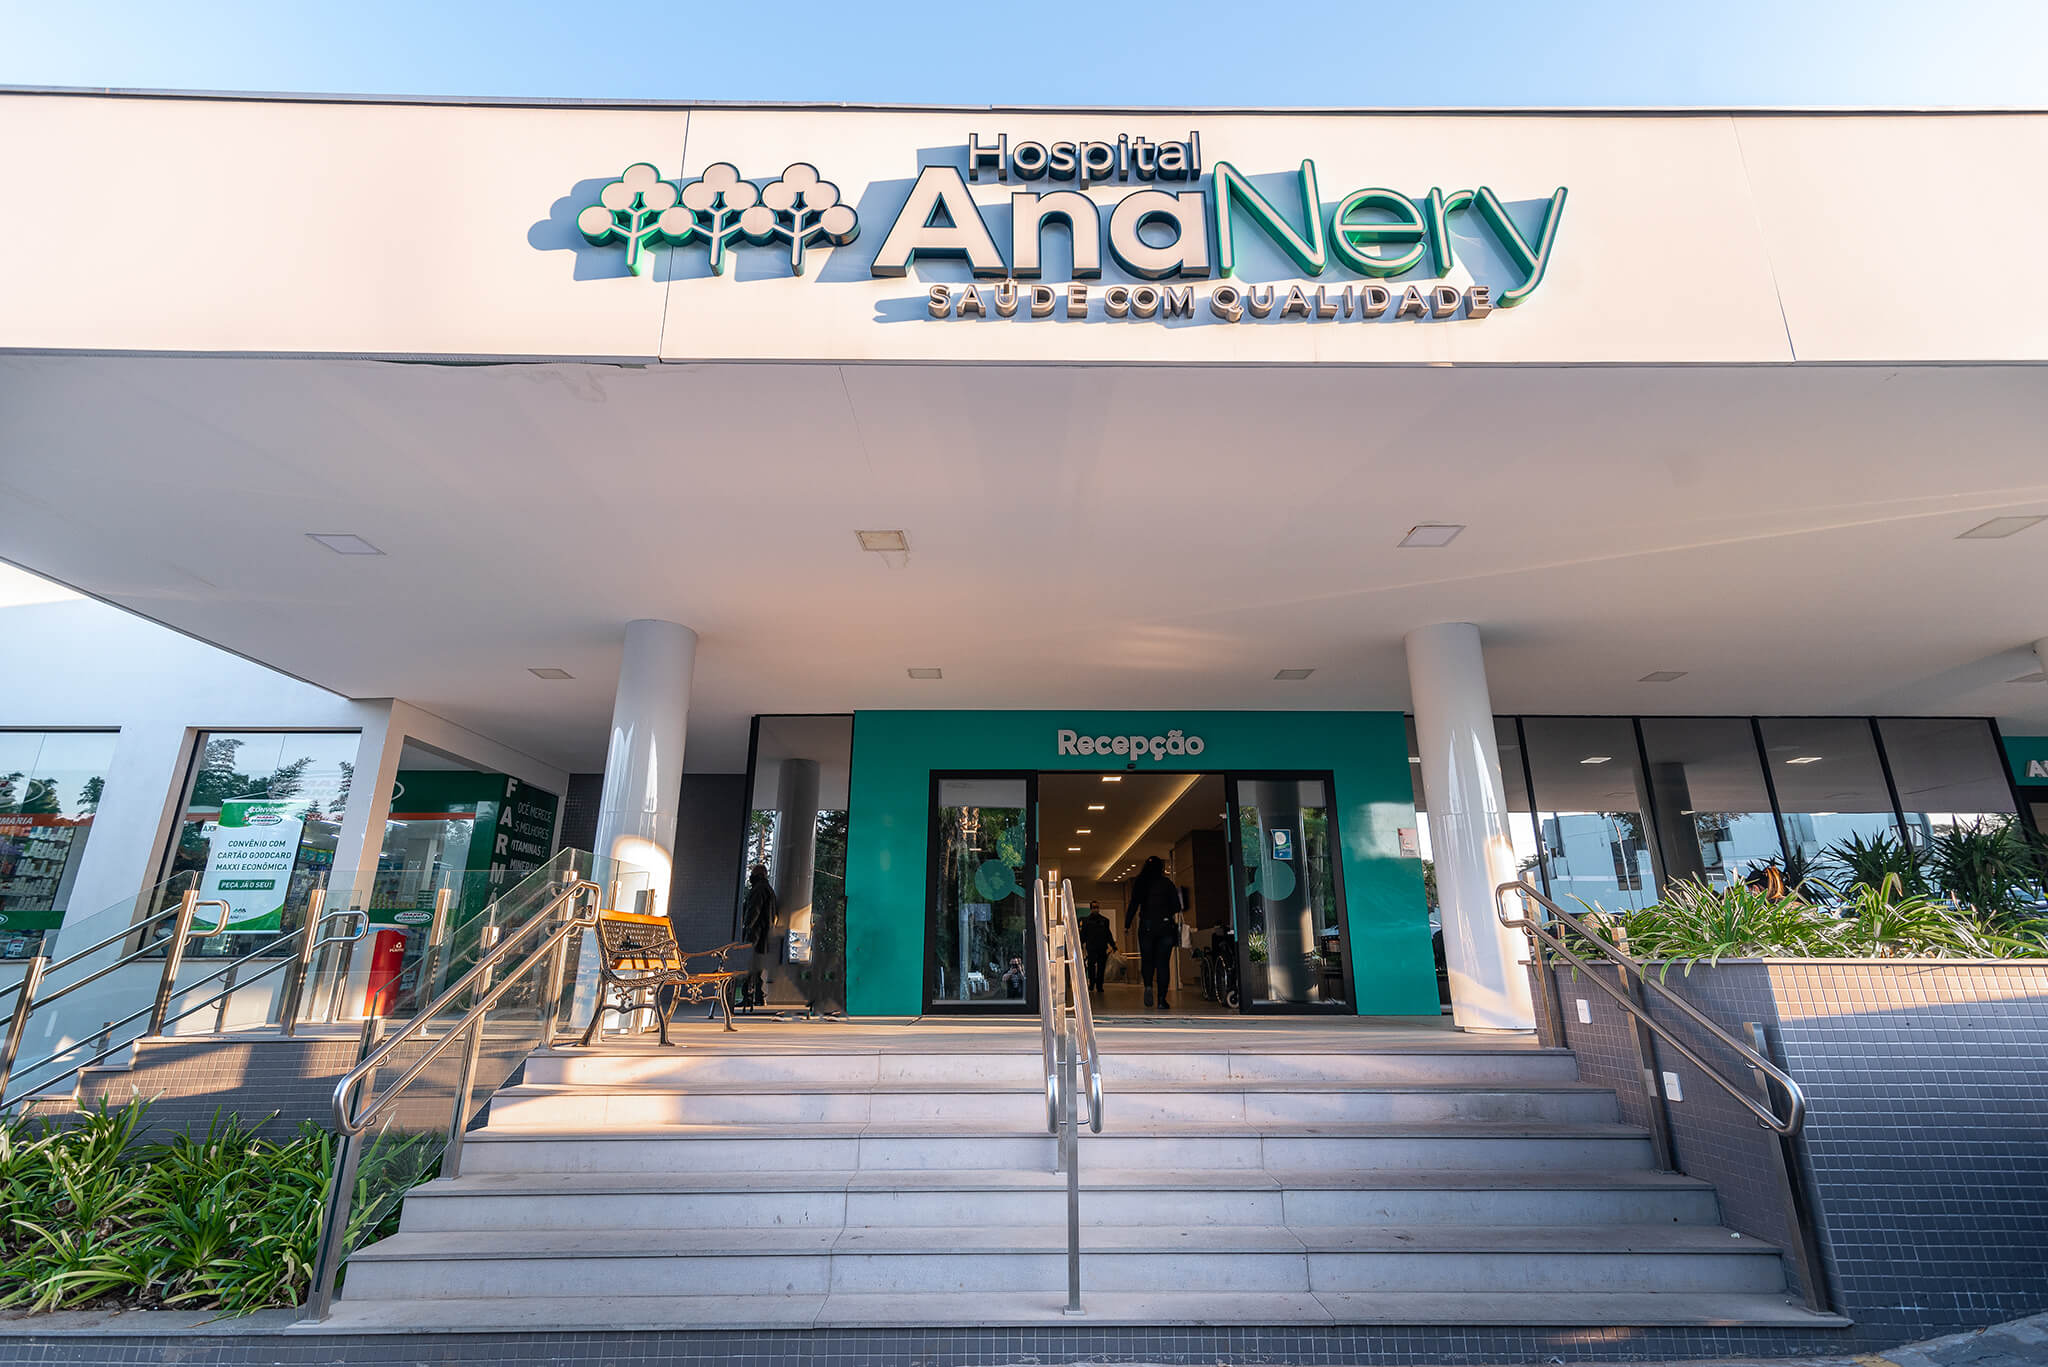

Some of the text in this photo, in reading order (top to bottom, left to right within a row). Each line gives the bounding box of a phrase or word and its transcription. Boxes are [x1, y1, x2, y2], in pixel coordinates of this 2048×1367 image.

[968, 131, 1201, 190] Hospital
[928, 278, 1494, 322] SAÚDE COM QUALIDADE
[1057, 729, 1205, 761] Recepção
[228, 839, 267, 847] CONVÊNIO
[217, 850, 248, 859] CARTÃO
[215, 861, 288, 871] MAXXI ECONÔMICA
[221, 881, 238, 889] PEÇA
[239, 880, 249, 888] JÁ
[255, 881, 273, 889] SEU!
